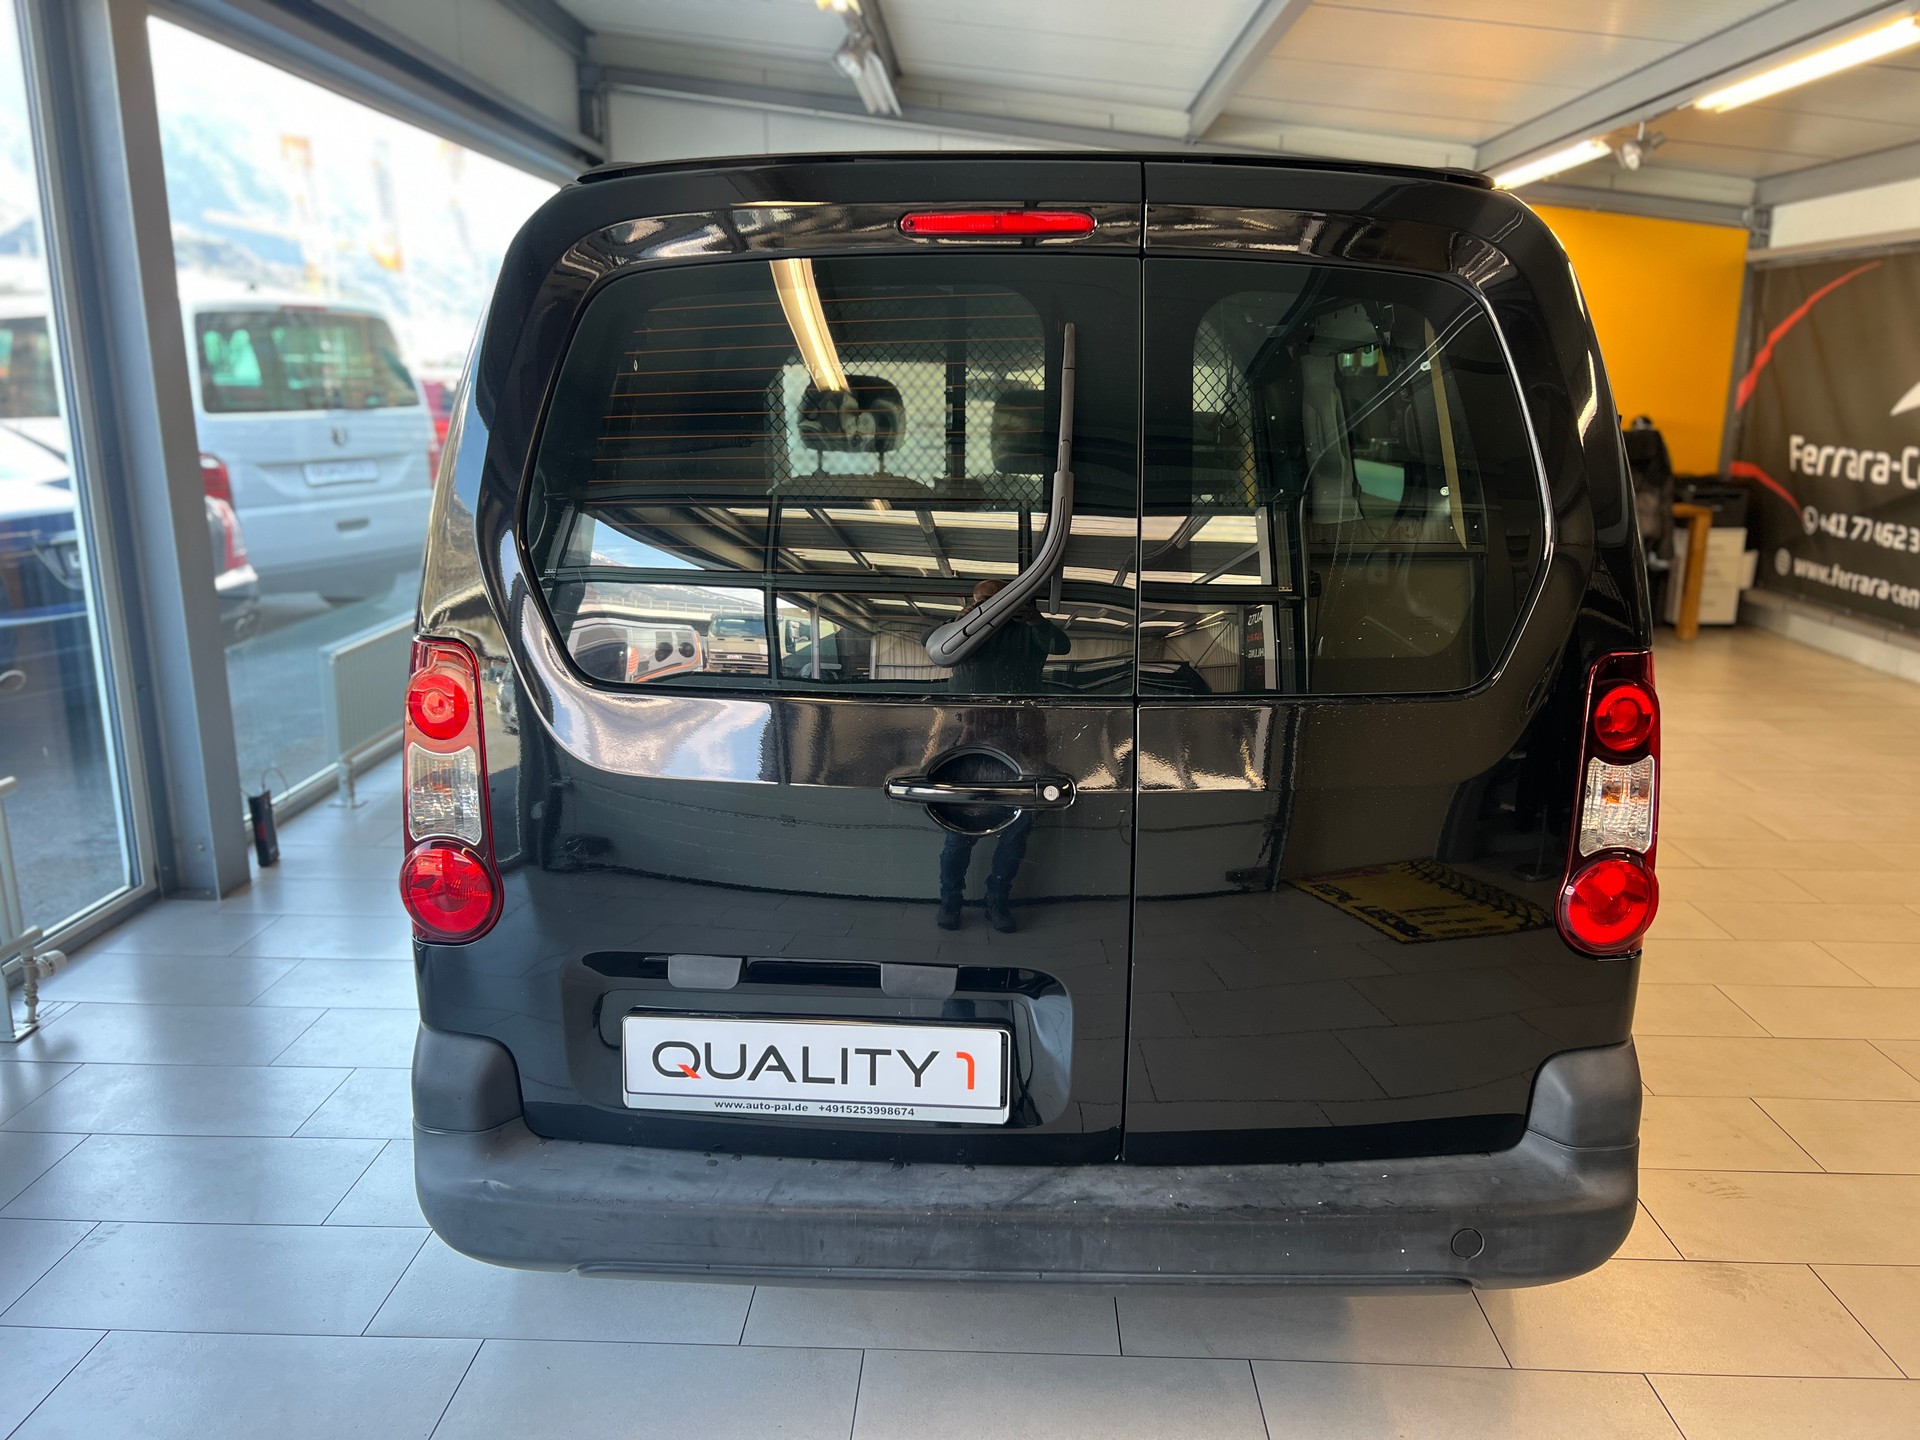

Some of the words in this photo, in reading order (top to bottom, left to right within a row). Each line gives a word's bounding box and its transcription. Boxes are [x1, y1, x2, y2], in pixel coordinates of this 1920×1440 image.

[1789, 434, 1920, 490] Ferrara-C
[651, 1040, 941, 1089] QUALITY
[956, 1050, 976, 1091] 1
[714, 1100, 808, 1113] www.auto-pal.de
[818, 1104, 915, 1117] +4915253998674
